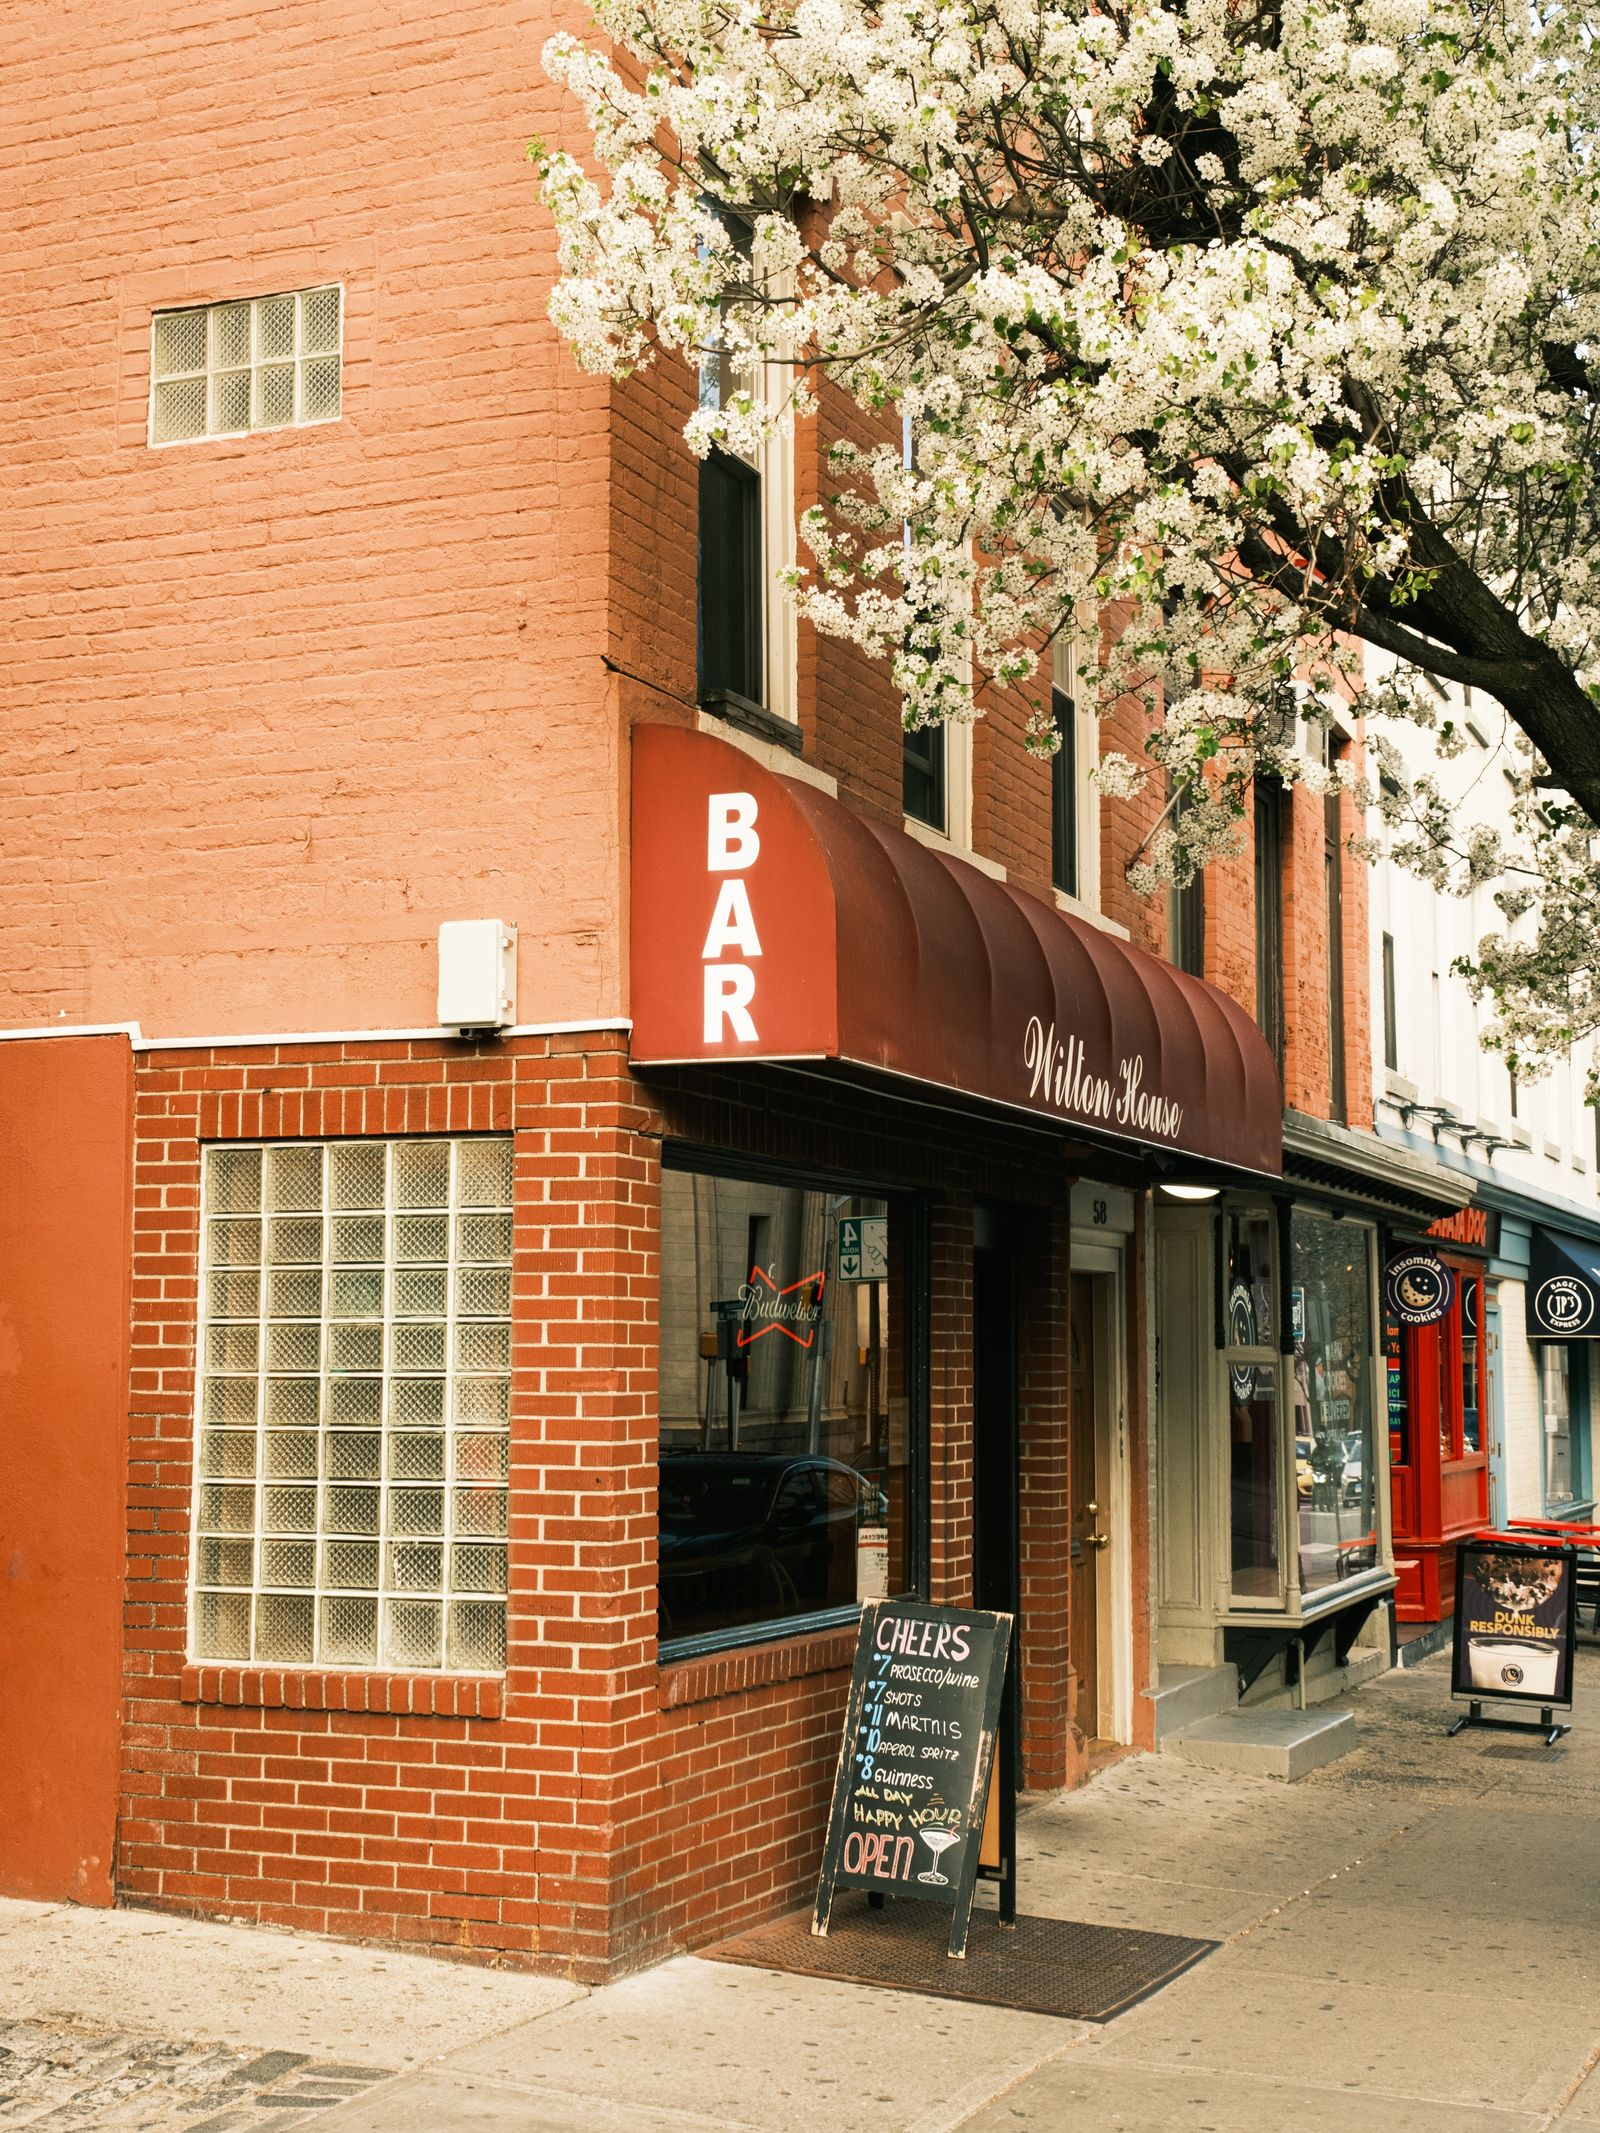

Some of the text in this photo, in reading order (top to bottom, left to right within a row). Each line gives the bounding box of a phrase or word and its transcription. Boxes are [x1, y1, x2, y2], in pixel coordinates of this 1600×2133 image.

[702, 792, 763, 1043] BAR
[1024, 1015, 1184, 1138] Wilton House
[1093, 1200, 1107, 1224] 58
[1388, 1256, 1442, 1276] insomnia
[1550, 1280, 1578, 1291] BAGEL
[738, 1284, 821, 1321] Budweiser
[1555, 1295, 1575, 1316] JP'S
[1400, 1307, 1443, 1323] cookies
[1549, 1317, 1581, 1328] EXPRESS
[1494, 1611, 1536, 1626] DUNK
[876, 1617, 971, 1662] CHEERS
[1469, 1620, 1560, 1640] RESPONSIBLY
[883, 1690, 922, 1707] SHOTS
[878, 1741, 916, 1758] APEROL
[854, 1784, 913, 1807] ALL DAY
[854, 1801, 962, 1831] HAPPY HOUR
[843, 1831, 915, 1881] OPEN
